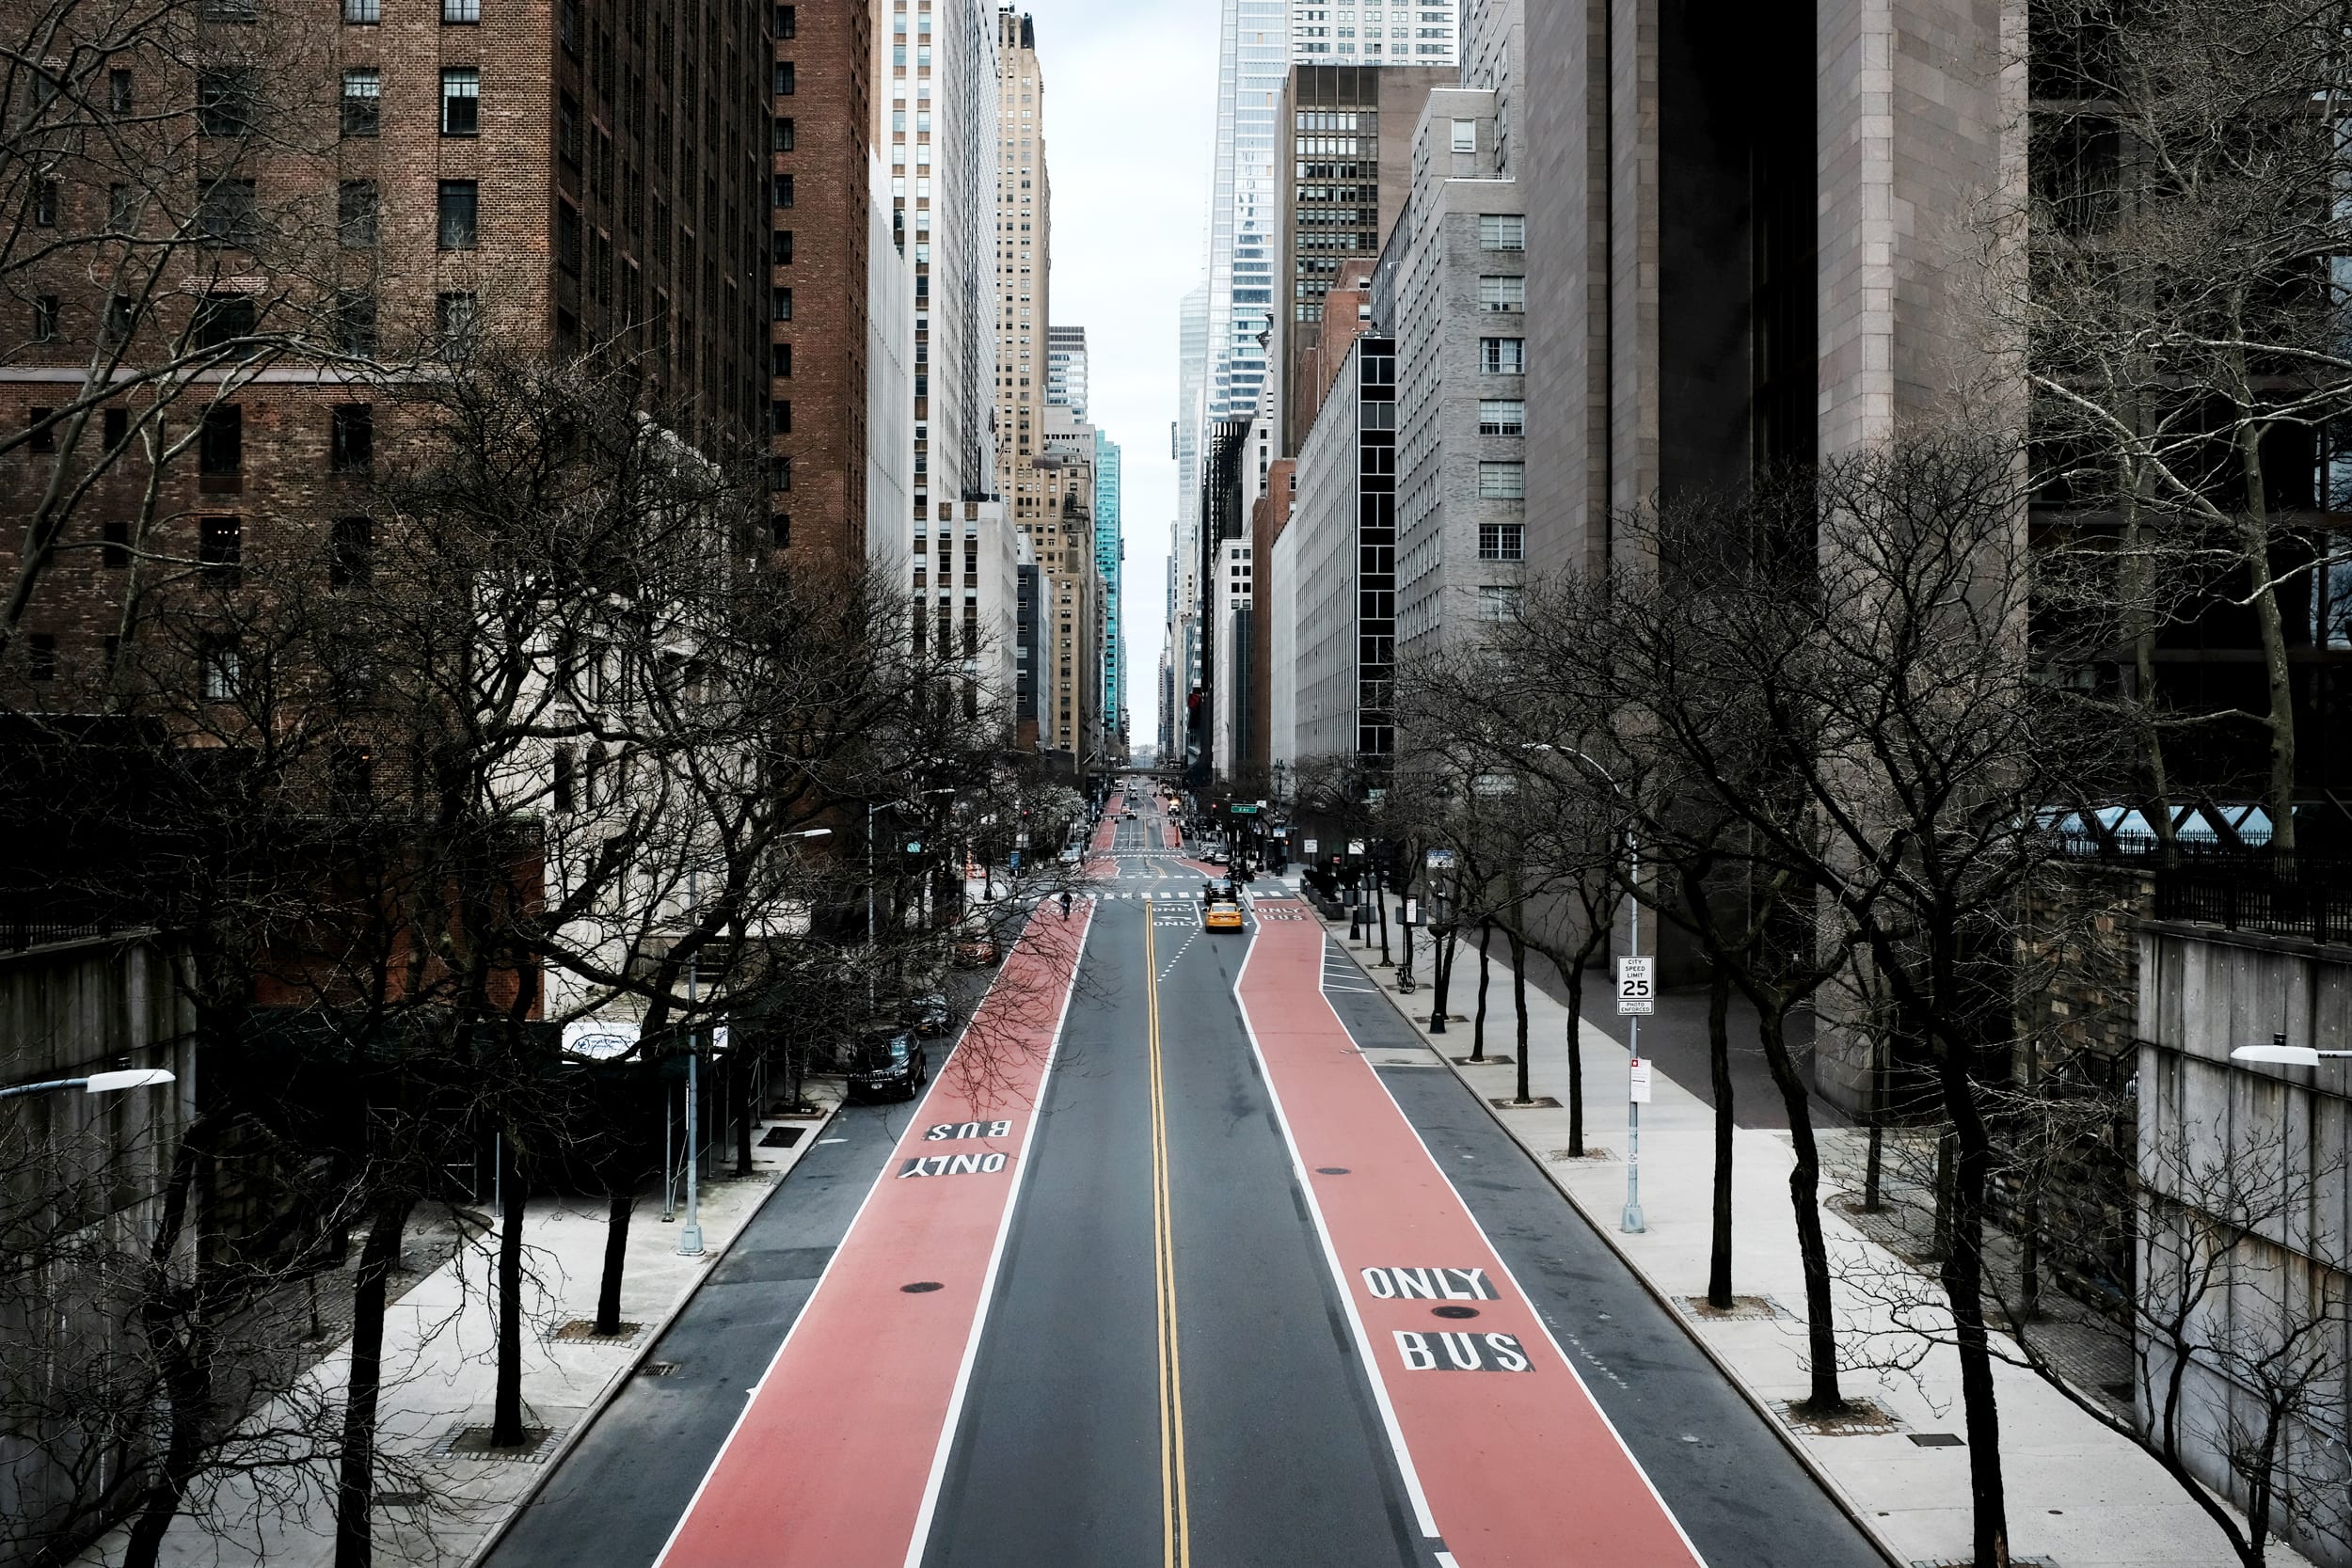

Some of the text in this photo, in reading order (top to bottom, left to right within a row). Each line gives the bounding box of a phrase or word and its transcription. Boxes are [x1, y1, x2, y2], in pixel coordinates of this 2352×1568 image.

[1623, 980, 1648, 996] 25
[928, 1119, 1013, 1141] BUS
[898, 1153, 1006, 1179] ONLY
[1361, 1266, 1488, 1300] ONLY
[1391, 1330, 1528, 1371] BUS
